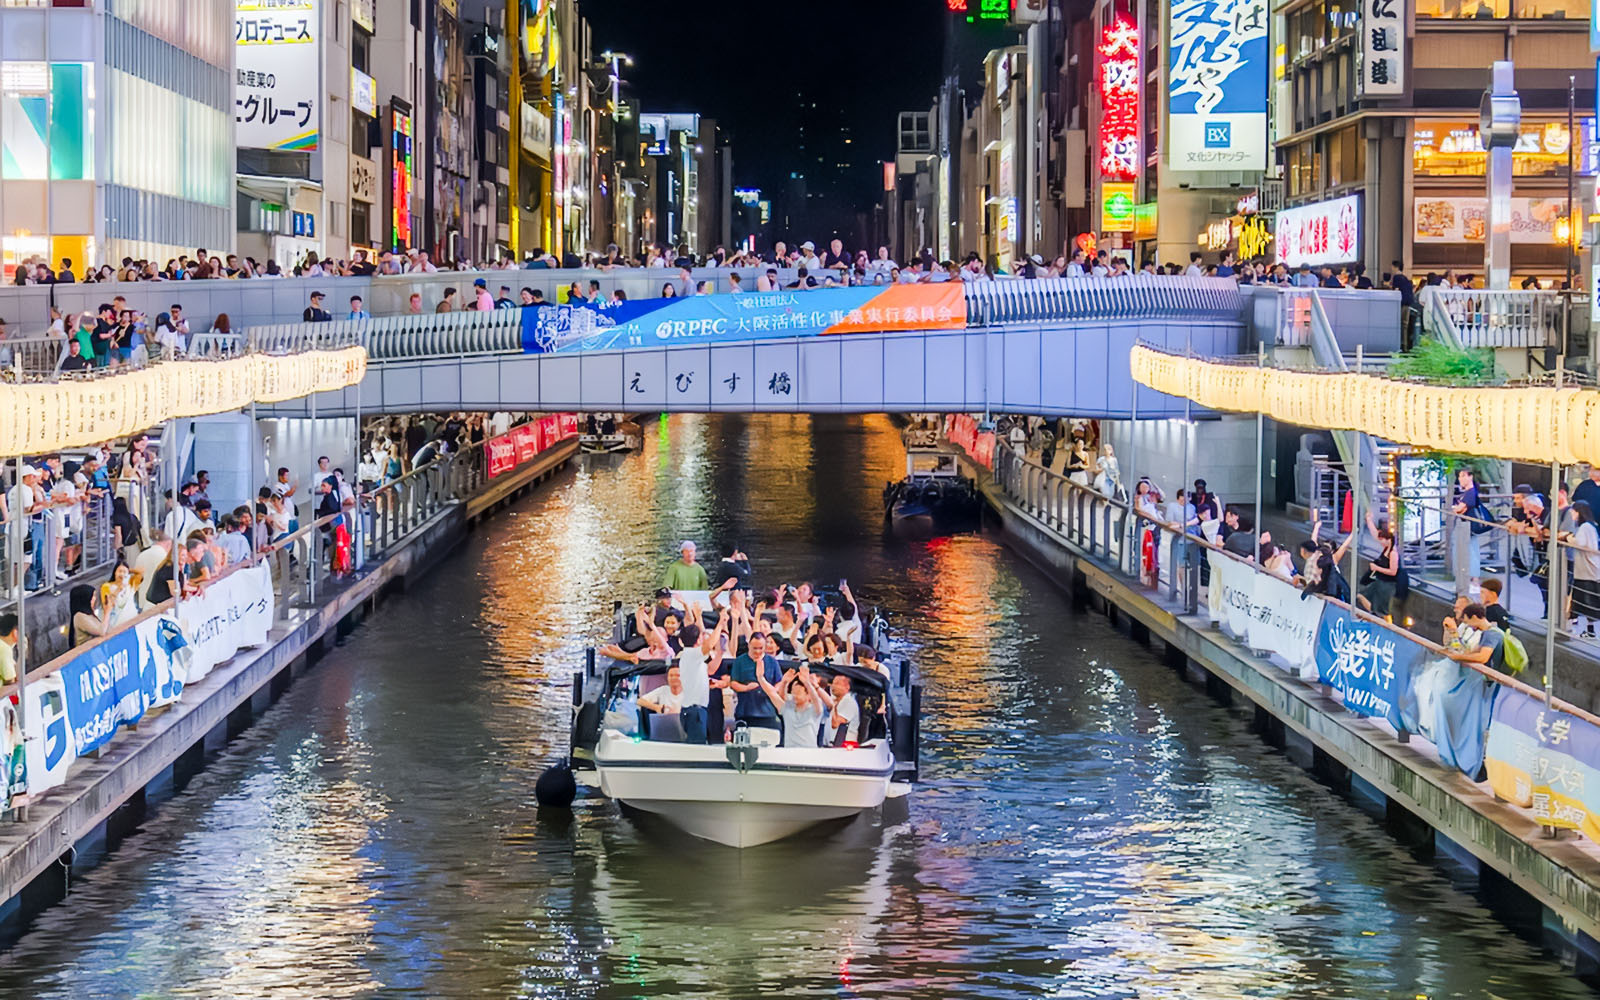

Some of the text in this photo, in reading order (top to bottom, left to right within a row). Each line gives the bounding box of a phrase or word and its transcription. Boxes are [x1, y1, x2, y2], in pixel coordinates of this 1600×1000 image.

[1099, 18, 1138, 176] 大阪王将
[1207, 127, 1229, 142] BX
[1186, 152, 1252, 162] 文化シャッター
[734, 306, 952, 335] 大阪活性化事業実行委員会
[629, 371, 792, 396] えびす橋
